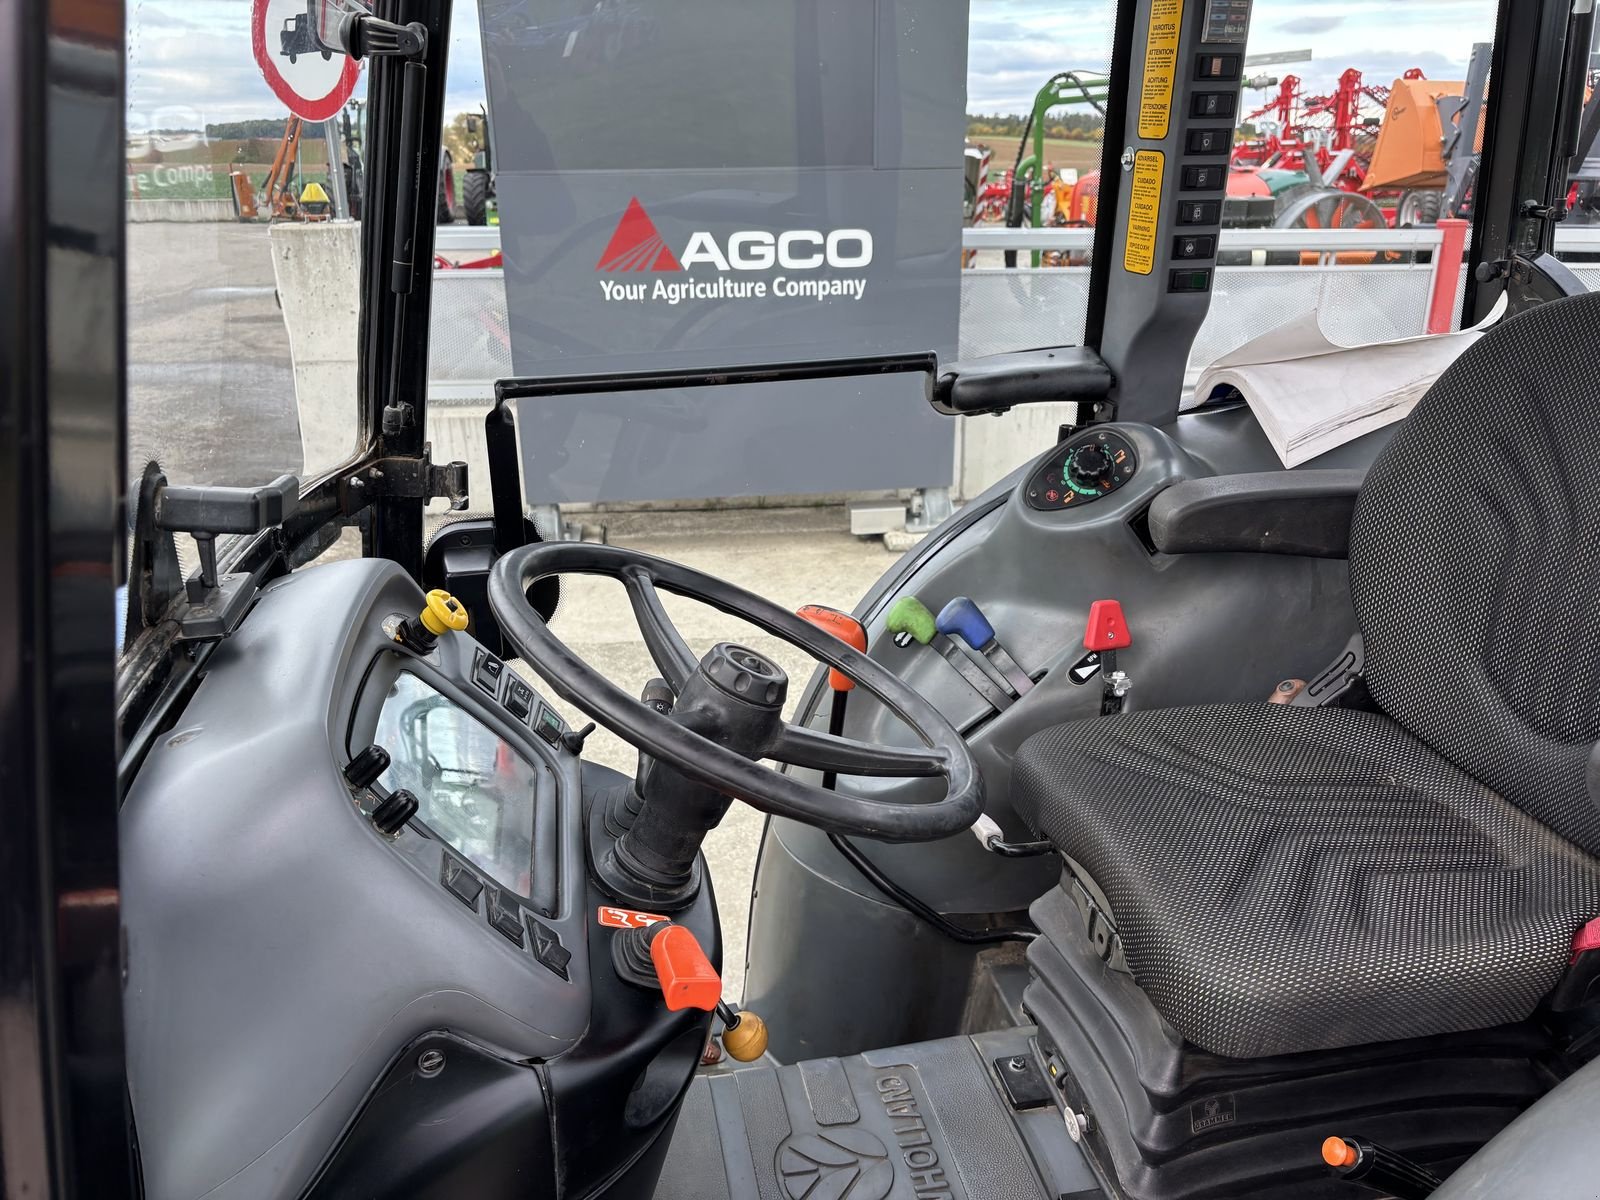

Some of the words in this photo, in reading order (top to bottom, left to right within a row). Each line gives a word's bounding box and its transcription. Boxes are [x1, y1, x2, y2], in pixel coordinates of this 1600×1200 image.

[1149, 48, 1175, 56] ATTENTION
[1137, 177, 1156, 185] CUIDADO
[1134, 202, 1153, 211] CUIDADO
[679, 229, 873, 271] AGCO
[599, 280, 648, 301] Your
[652, 277, 767, 305] Agriculture
[772, 276, 867, 300] Company
